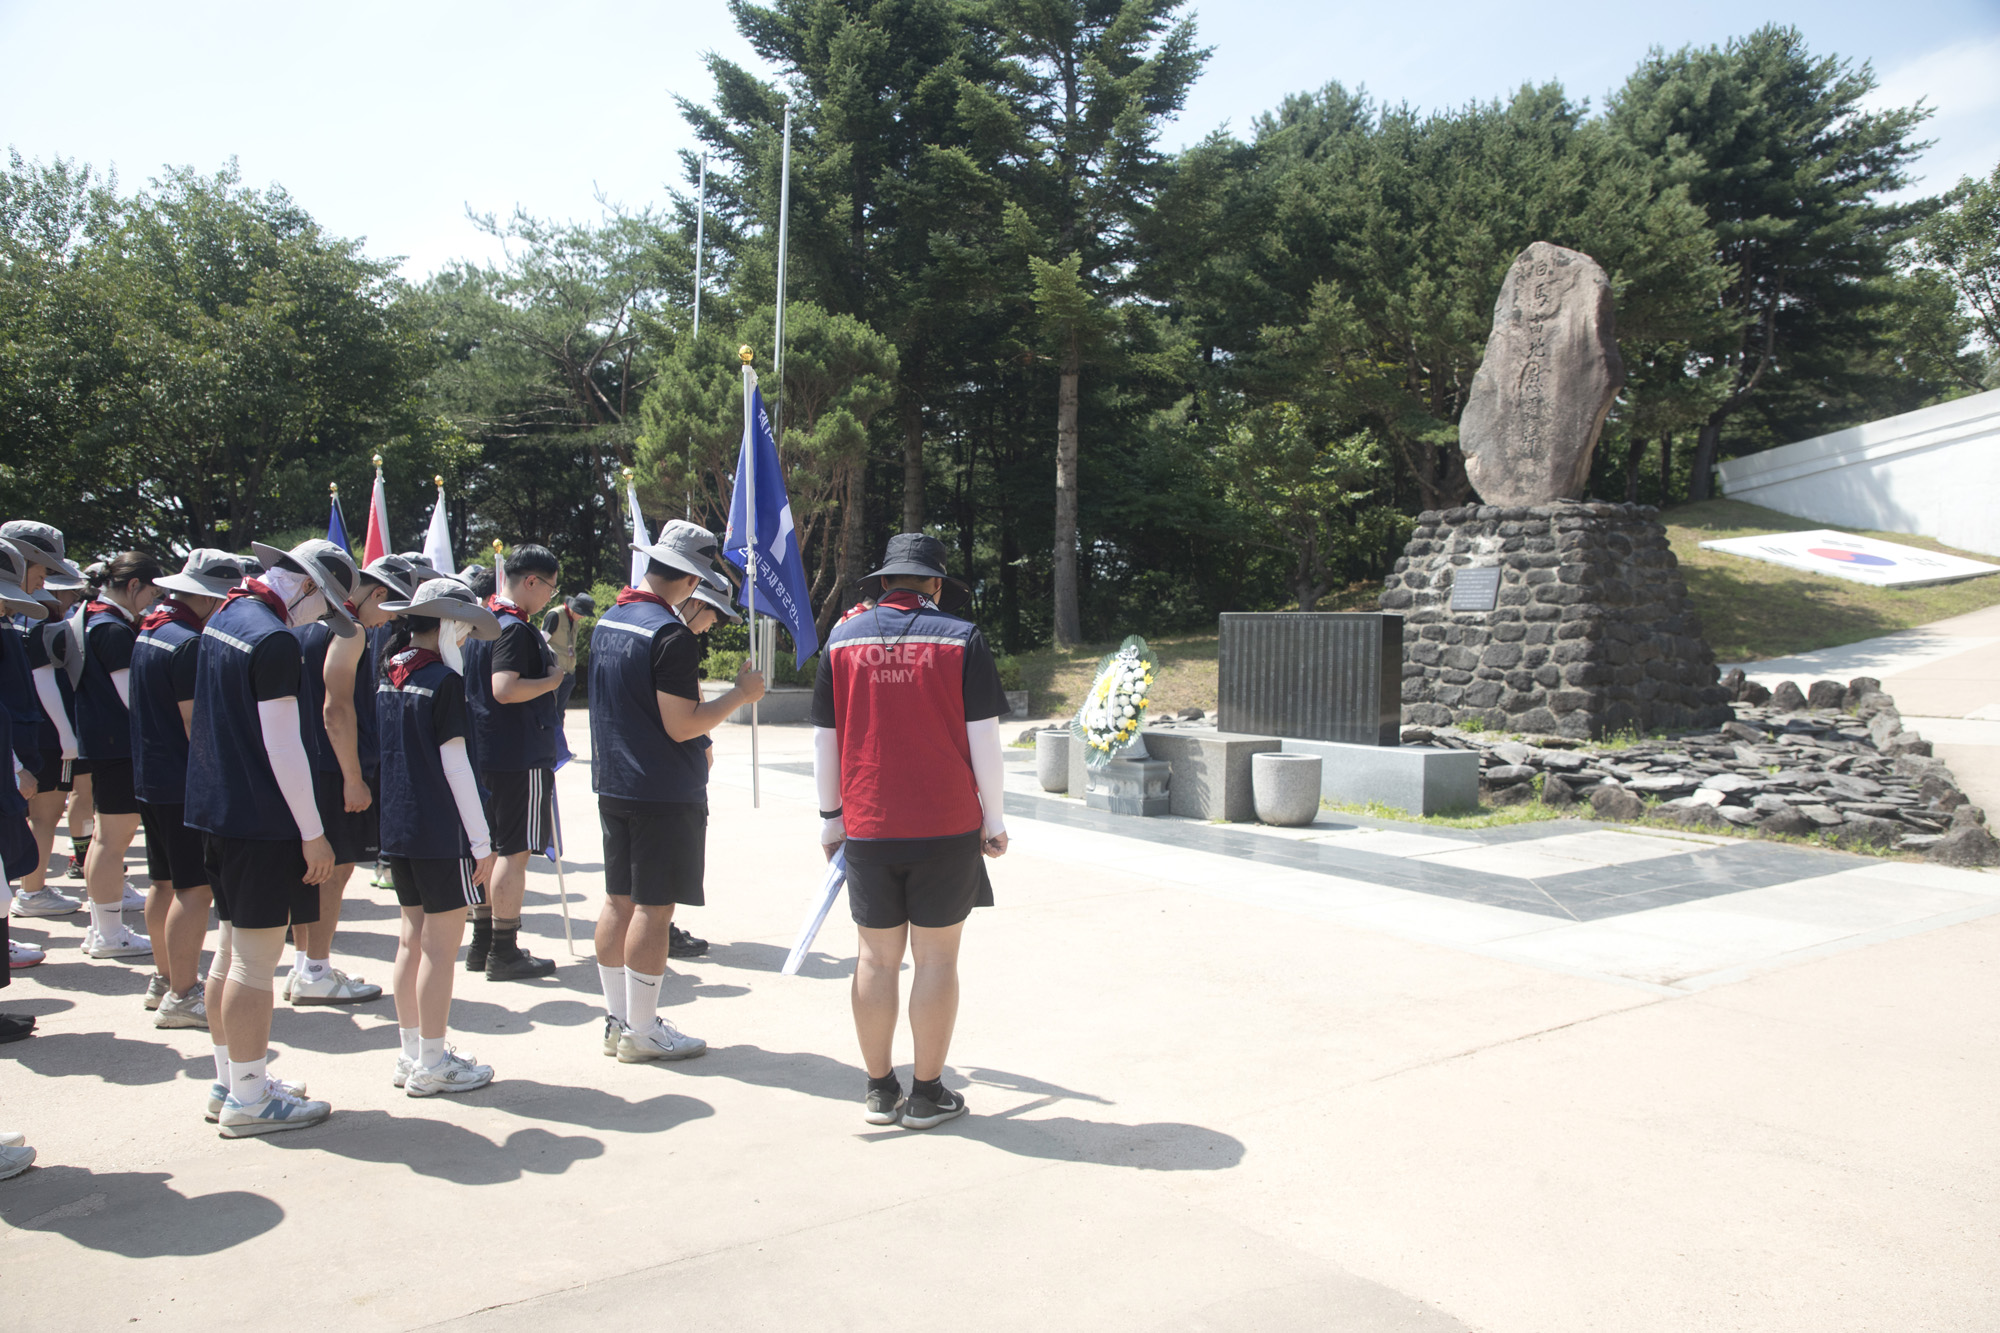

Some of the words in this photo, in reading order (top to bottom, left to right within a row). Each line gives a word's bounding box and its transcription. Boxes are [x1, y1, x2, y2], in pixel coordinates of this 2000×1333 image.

[592, 632, 634, 658] KOREA
[849, 644, 934, 669] KOREA
[869, 669, 915, 684] ARMY
